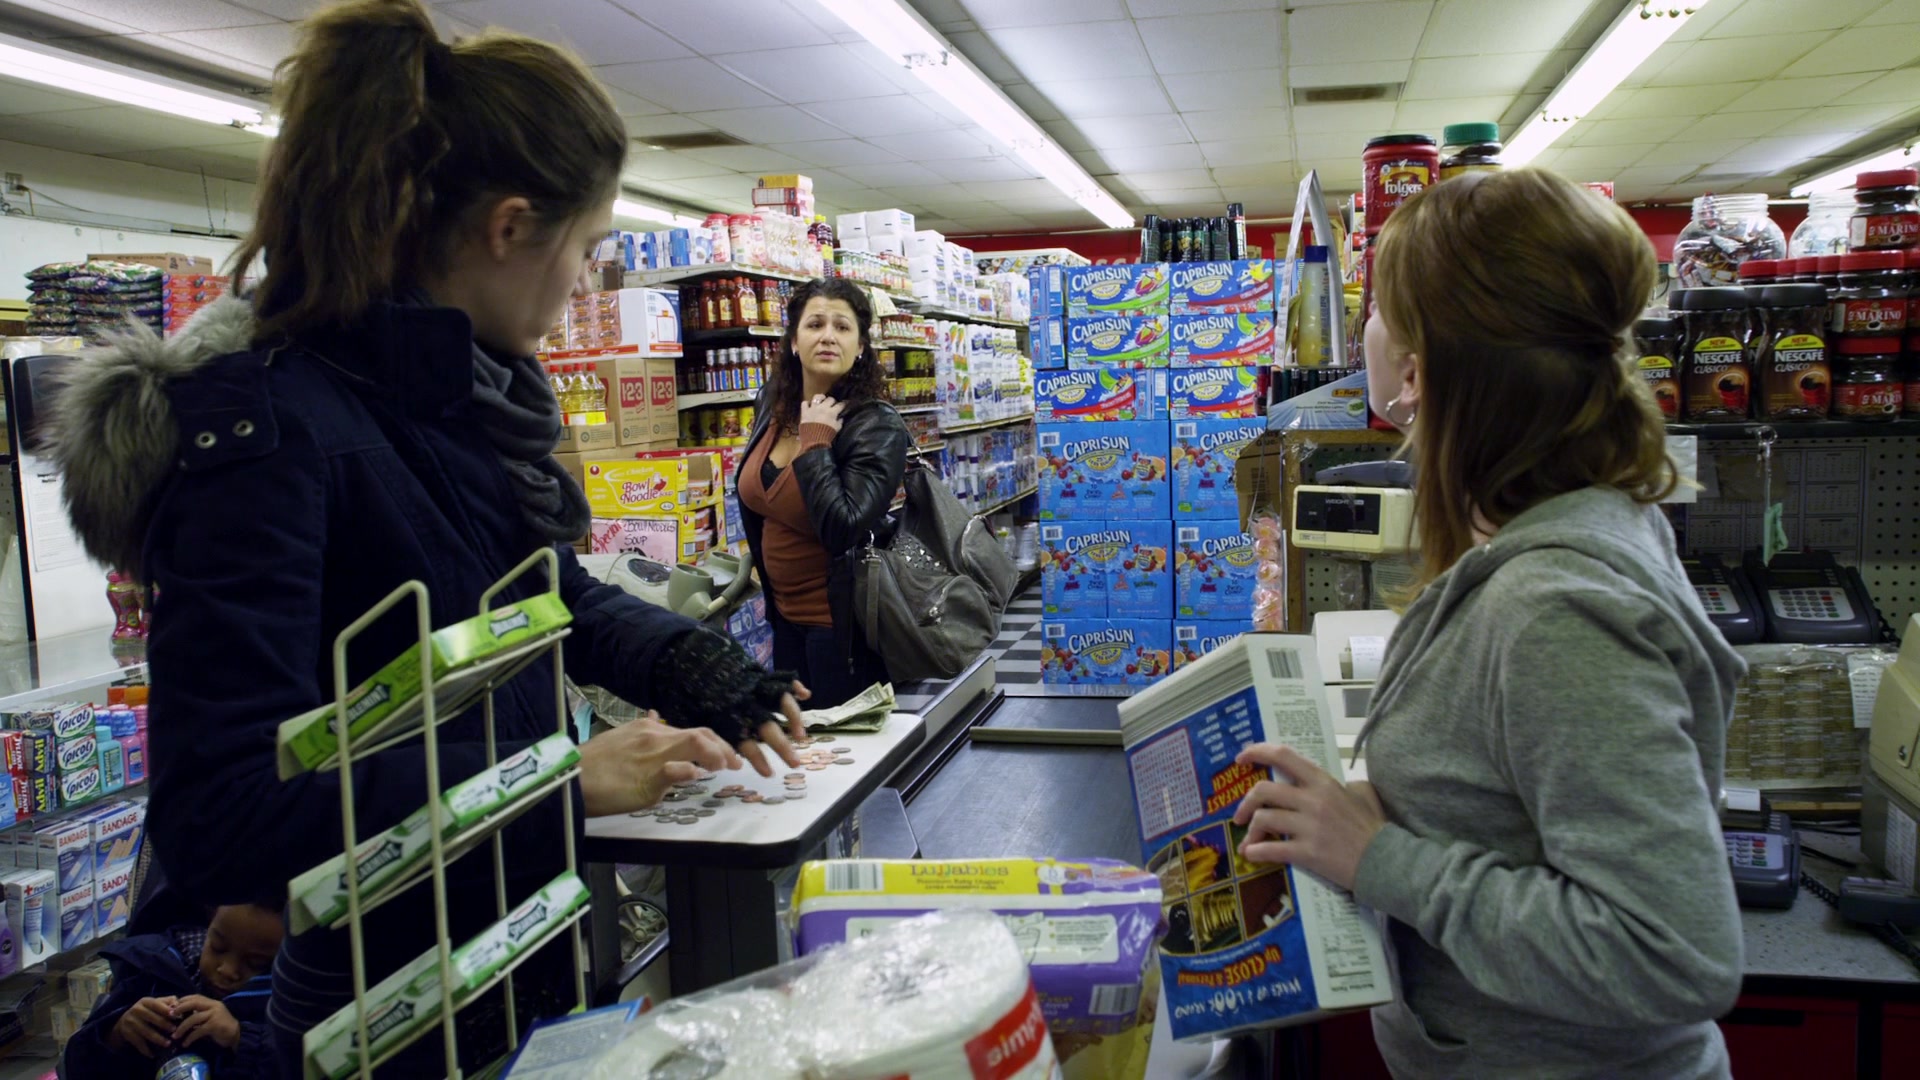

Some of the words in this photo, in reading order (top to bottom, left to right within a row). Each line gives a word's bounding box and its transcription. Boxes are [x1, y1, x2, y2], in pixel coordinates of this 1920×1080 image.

[1385, 179, 1423, 197] Folgers
[620, 488, 658, 505] Noodle
[102, 811, 138, 836] BANDAGE
[58, 827, 89, 848] BANDAGE
[62, 886, 92, 907] BANDAGE
[1224, 953, 1267, 986] CLOSE
[1208, 988, 1245, 1013] LOOK
